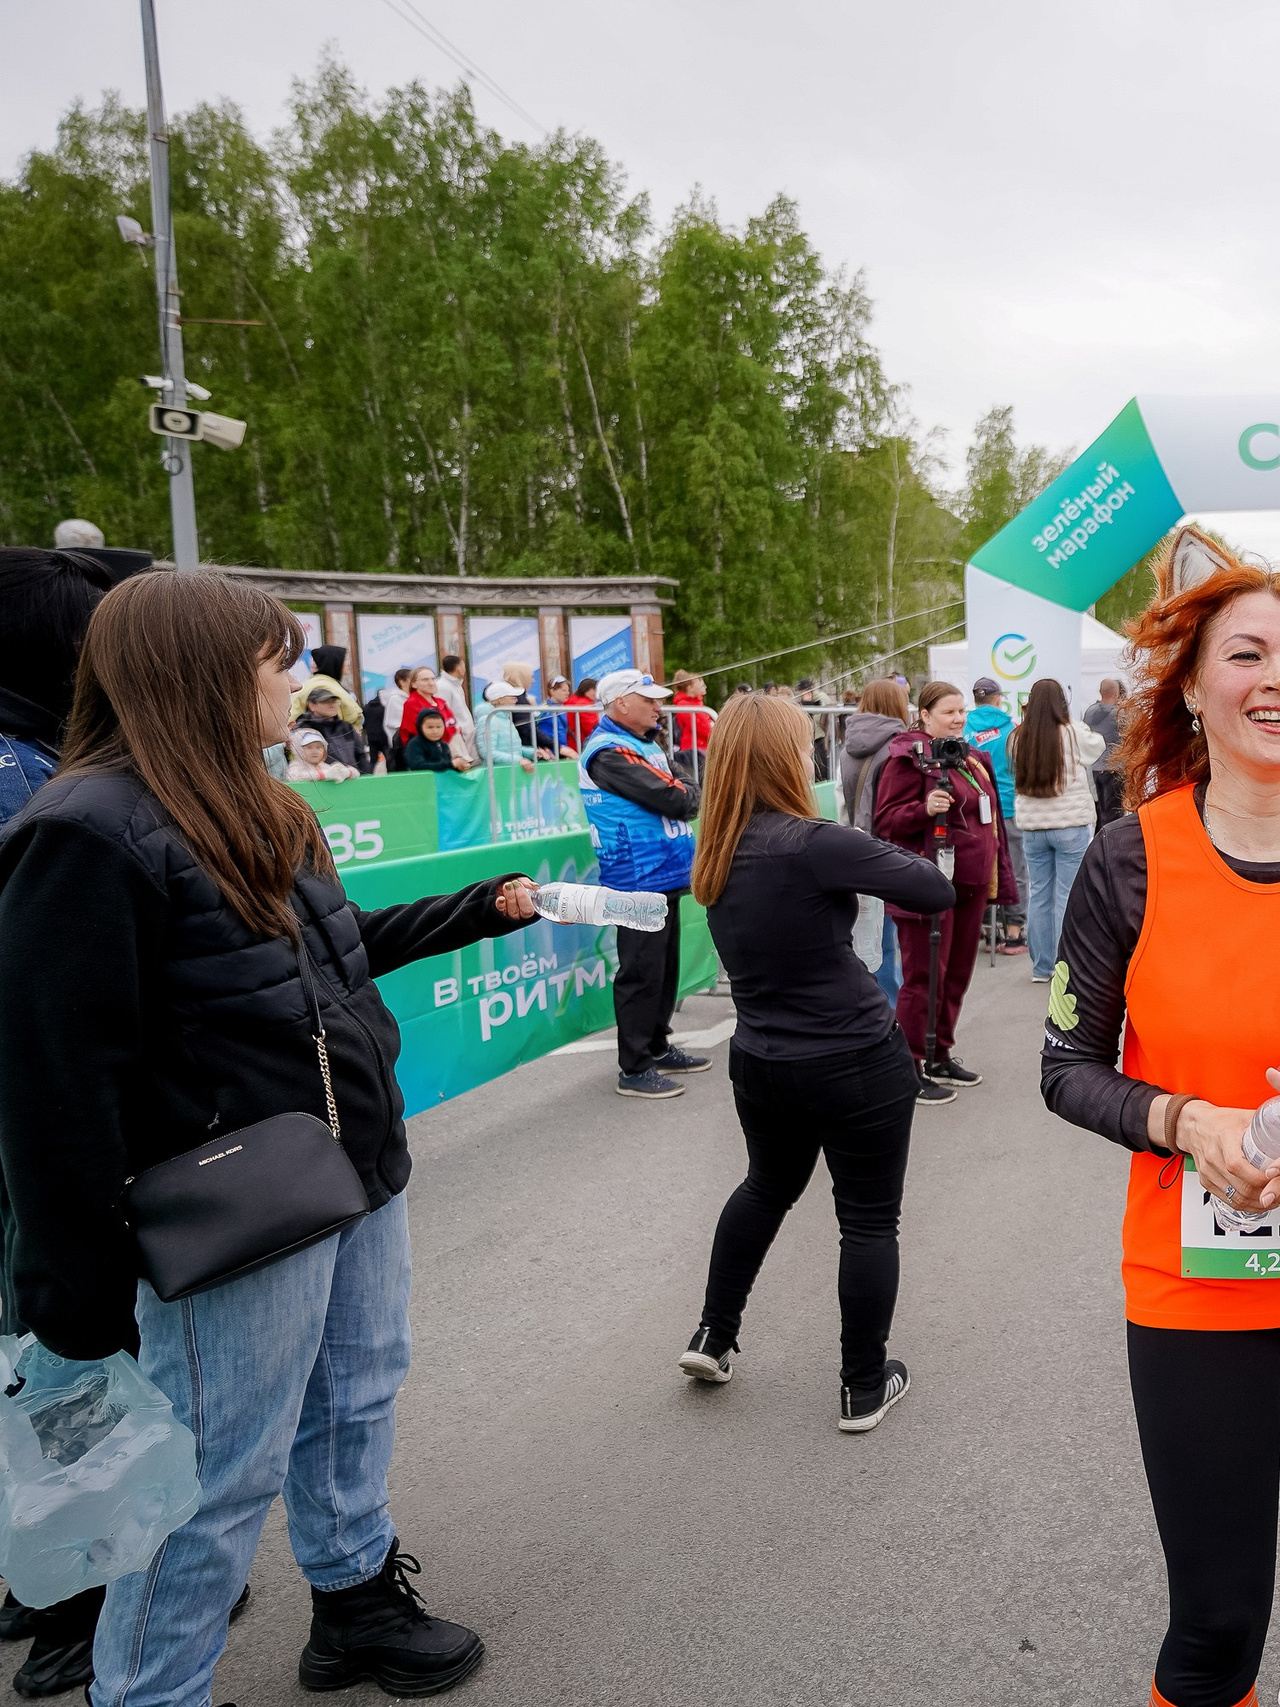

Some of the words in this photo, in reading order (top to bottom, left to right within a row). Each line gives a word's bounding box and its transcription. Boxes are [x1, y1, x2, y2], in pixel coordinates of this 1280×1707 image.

[1031, 461, 1120, 552] зелёный
[1046, 481, 1136, 570] марафон
[433, 976, 459, 1008] В
[467, 952, 559, 996] твоём
[198, 1152, 226, 1166] MICHAEL
[226, 1145, 243, 1155] KORS
